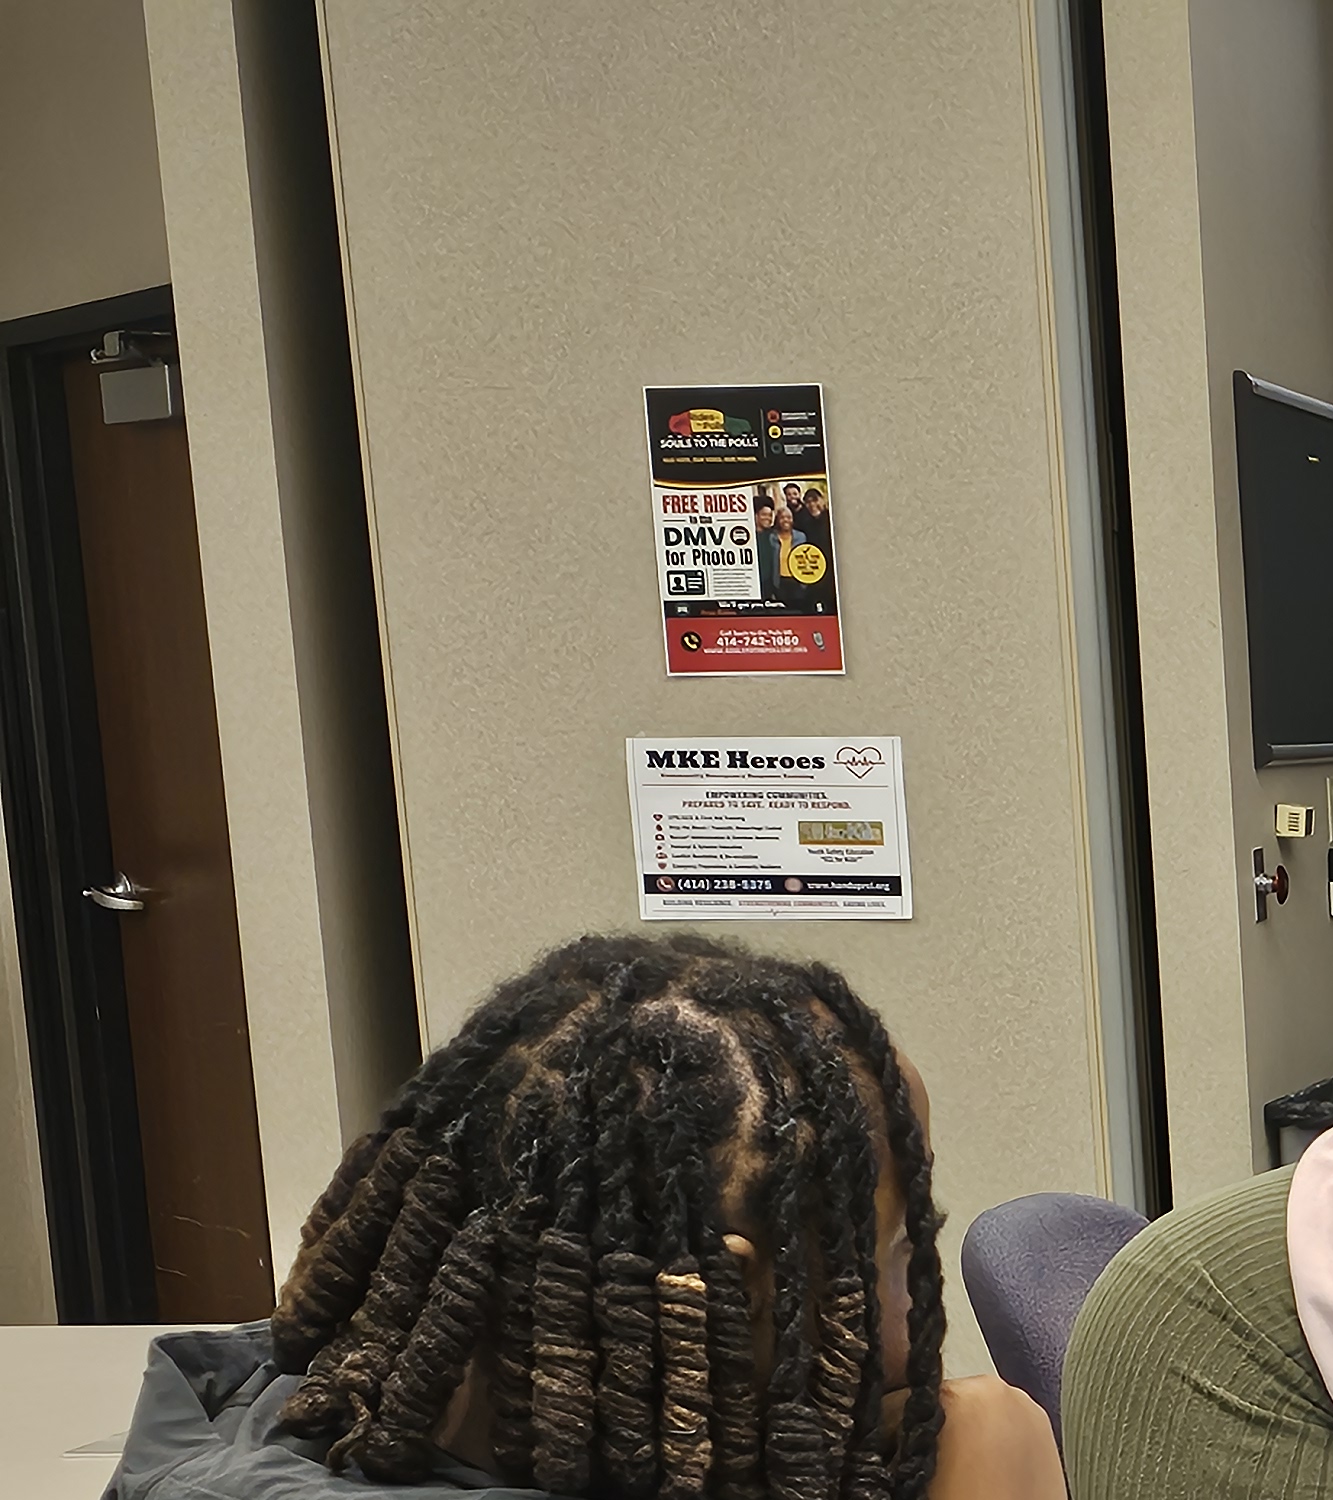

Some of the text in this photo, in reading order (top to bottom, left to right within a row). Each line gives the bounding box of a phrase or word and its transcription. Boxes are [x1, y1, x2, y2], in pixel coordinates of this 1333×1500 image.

[660, 437, 759, 448] SOULS TO THE POLLS
[662, 493, 747, 514] FREE RIDES
[664, 526, 726, 547] DMV
[665, 548, 753, 566] for Photo ID
[646, 750, 826, 769] MKE Heroes
[677, 878, 710, 891] (414)
